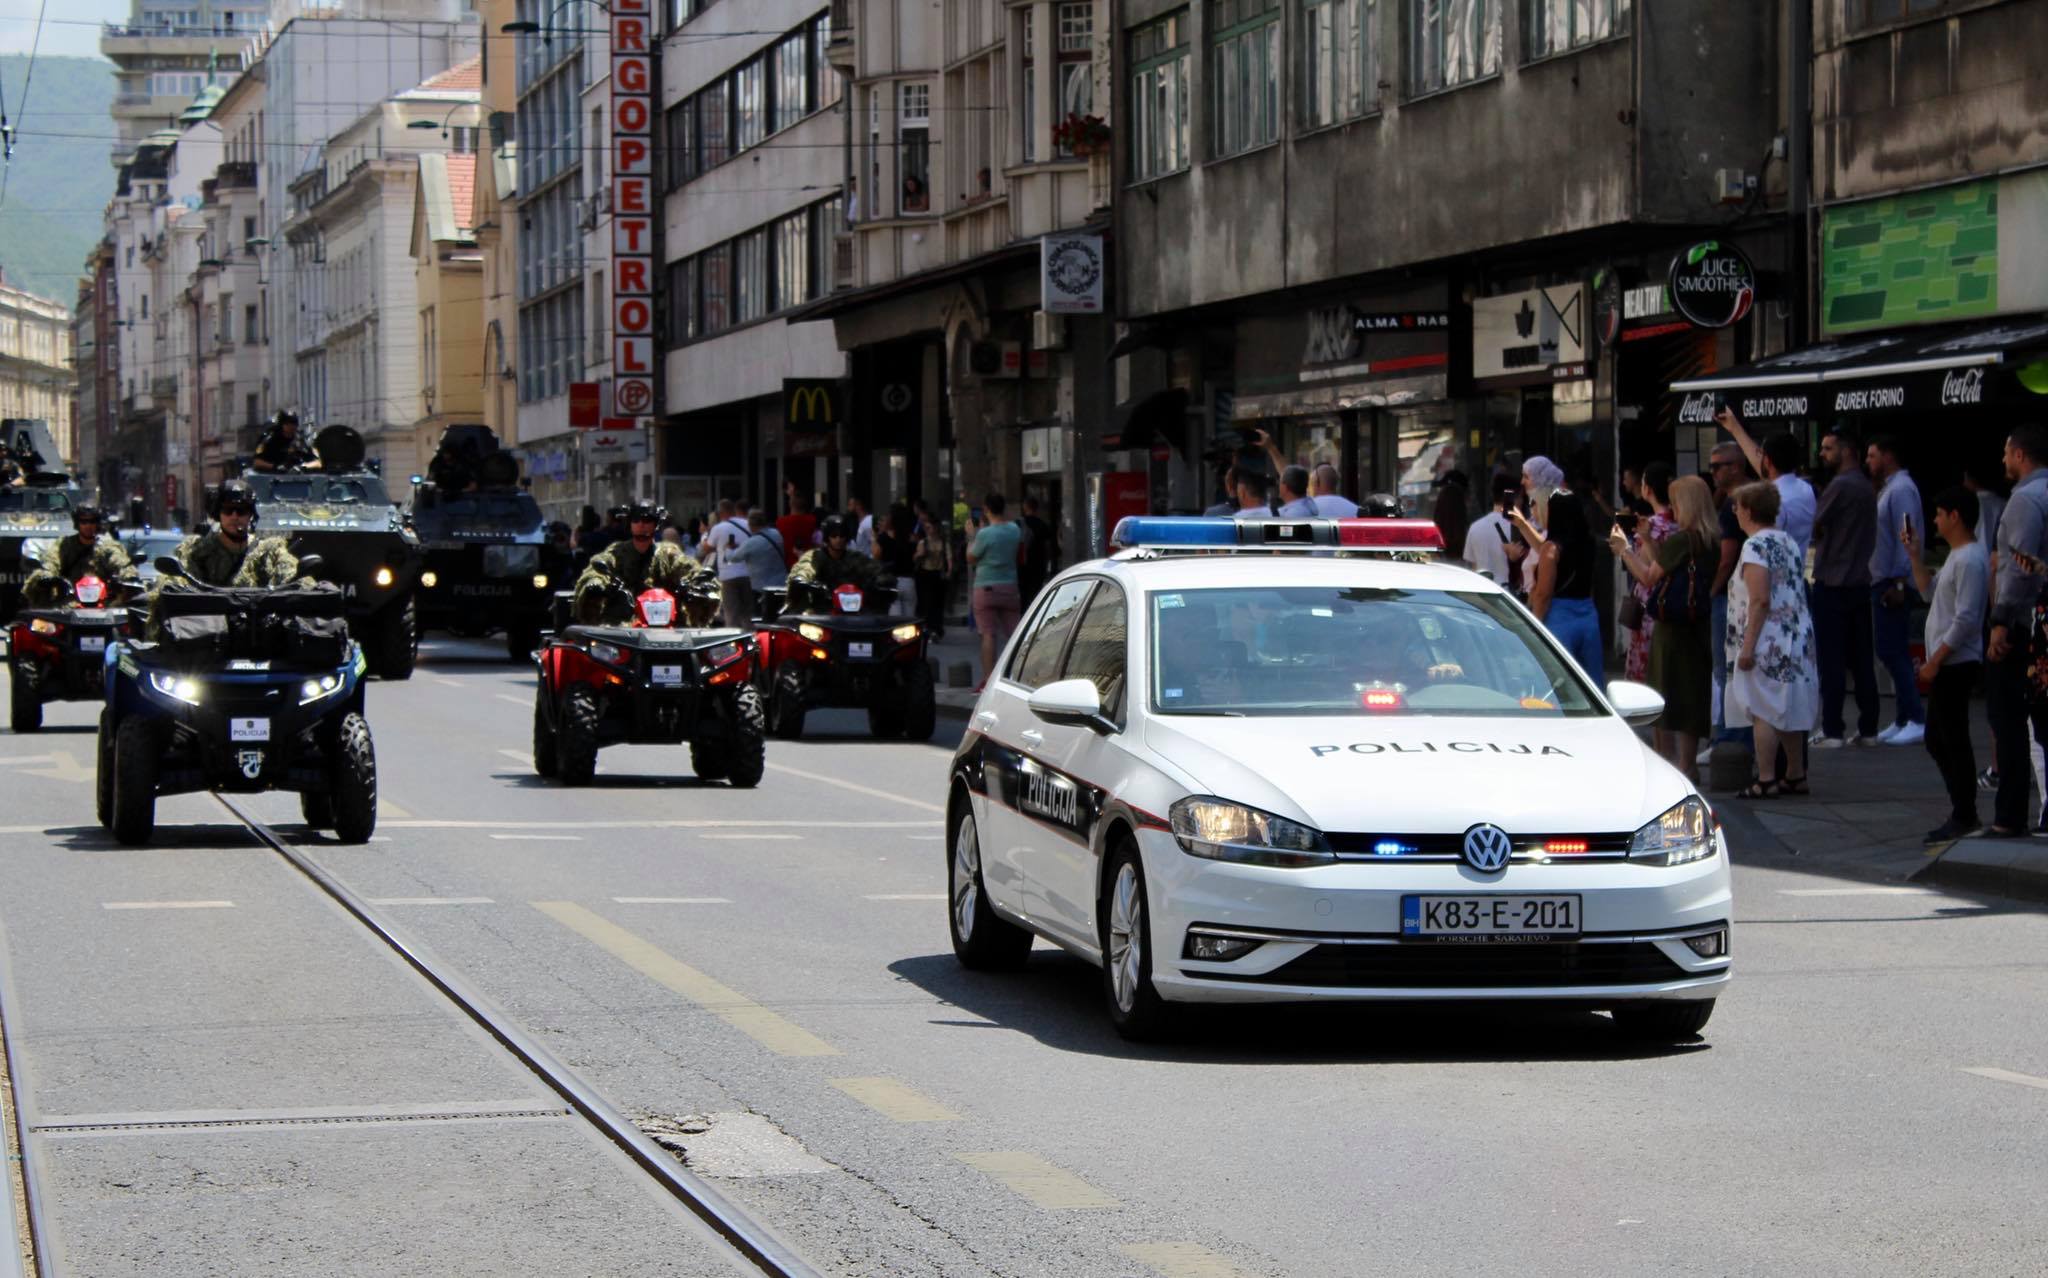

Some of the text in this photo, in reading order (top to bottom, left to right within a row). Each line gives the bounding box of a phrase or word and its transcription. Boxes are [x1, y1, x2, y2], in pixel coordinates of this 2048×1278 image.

[1701, 257, 1737, 276] JUICE
[1678, 276, 1750, 293] SMOOTHIES
[1624, 284, 1662, 320] HEALTHY
[1355, 317, 1399, 330] ALMA
[1743, 396, 1808, 417] GELATO FORINO
[1835, 386, 1904, 412] BUREK FORINO
[277, 519, 359, 528] POLICIJA
[452, 585, 513, 597] POLICIJA
[233, 730, 267, 738] POLICIJA
[1309, 741, 1574, 758] POLICIJA
[1028, 773, 1077, 827] POLICIJA
[1404, 902, 1574, 930] BIH K83-E-201
